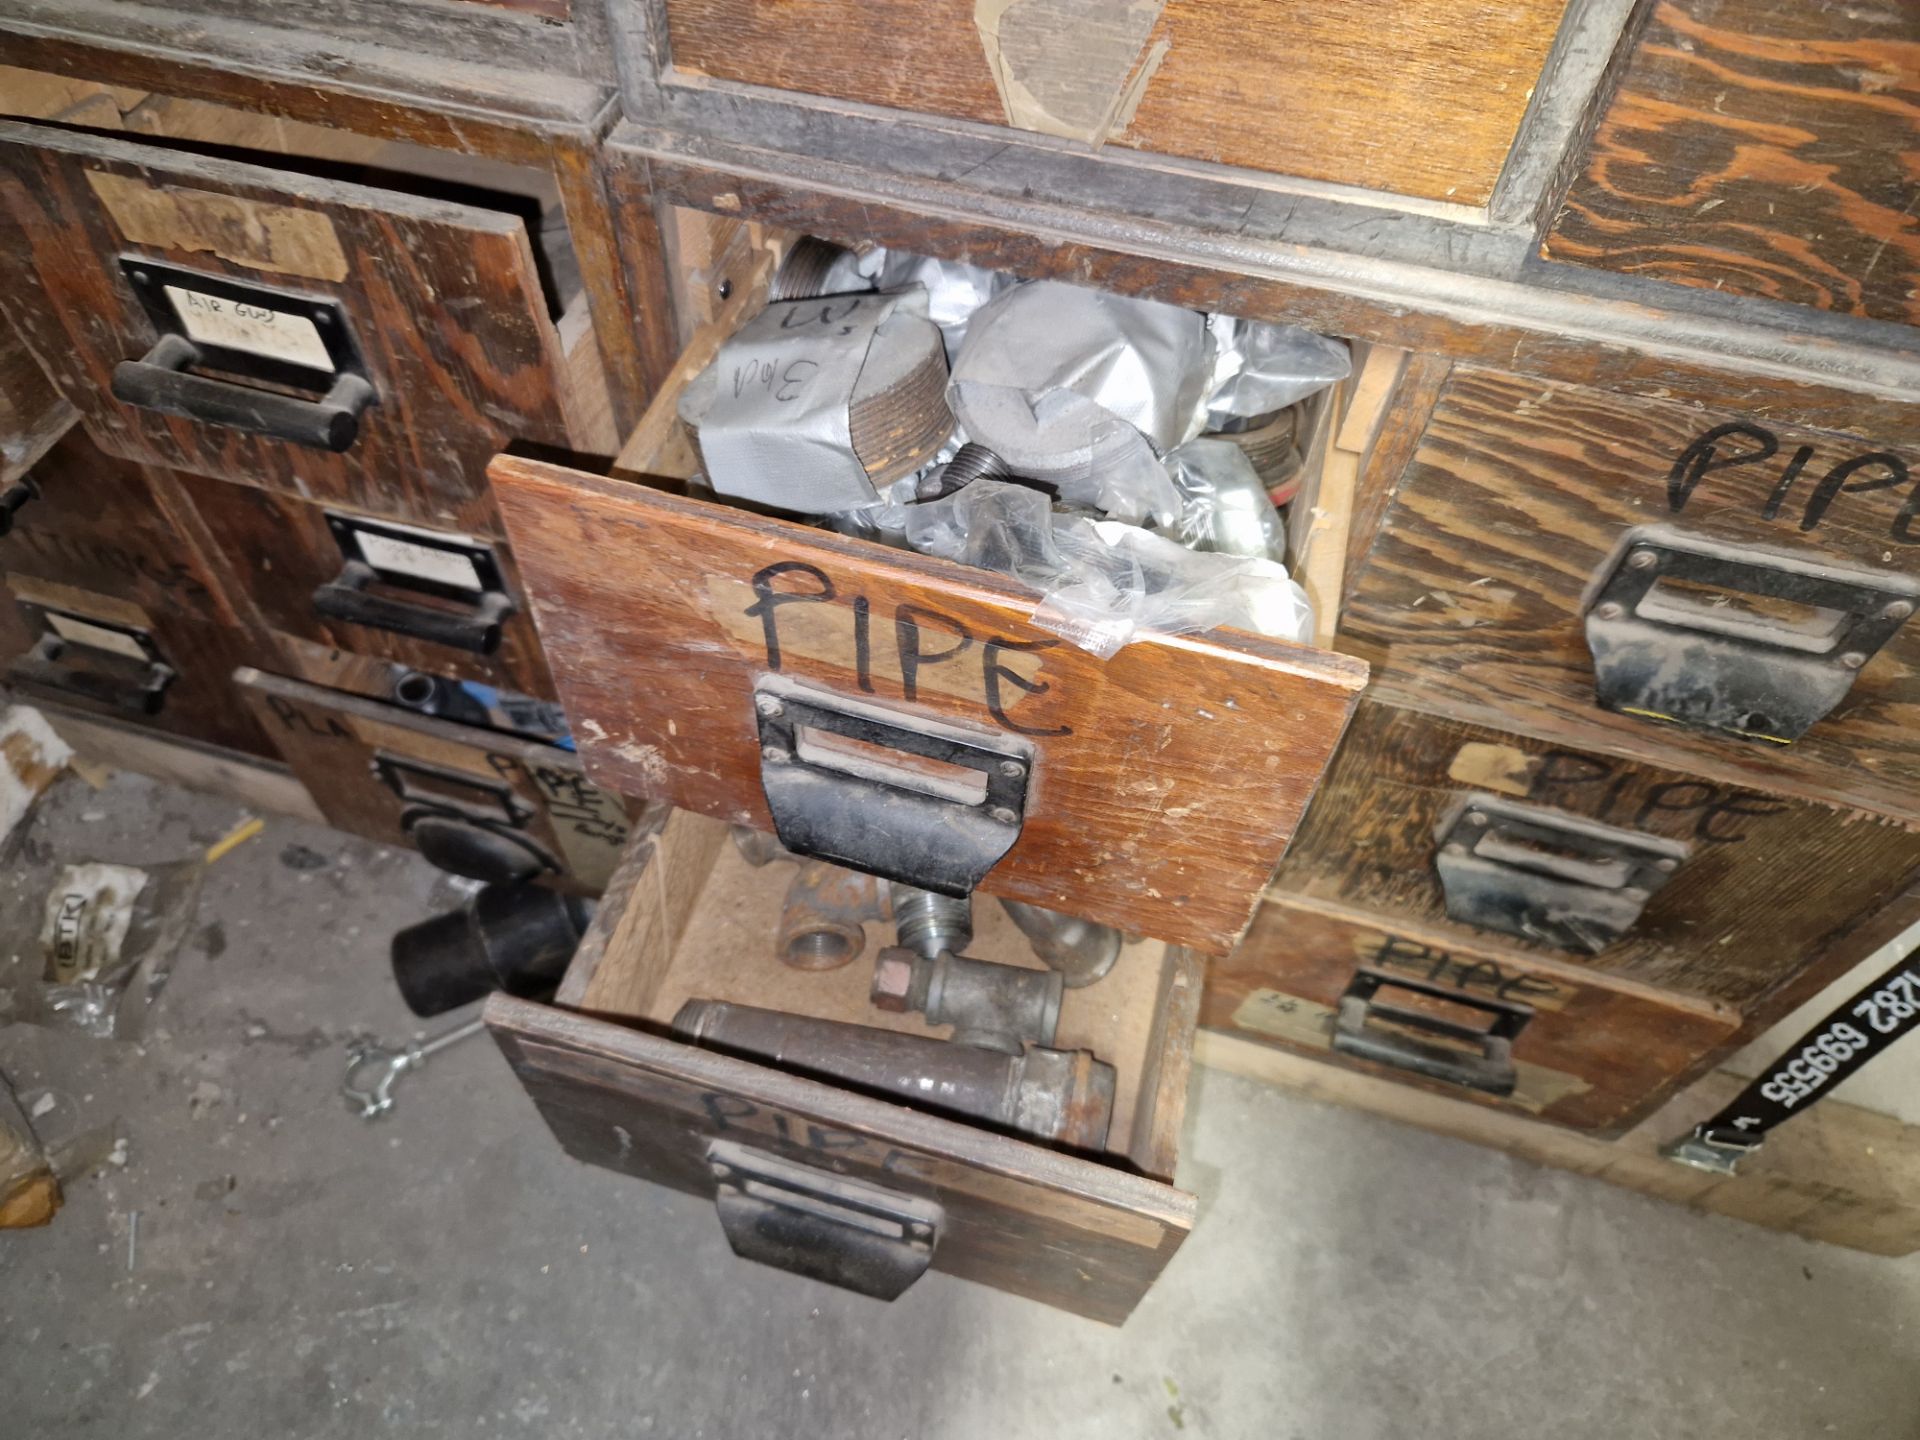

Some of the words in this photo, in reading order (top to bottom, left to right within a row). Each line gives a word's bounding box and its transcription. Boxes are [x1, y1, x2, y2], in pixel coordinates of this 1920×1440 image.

[185, 290, 223, 313] AIR
[735, 561, 1073, 736] PIPE
[1526, 751, 1790, 844] PIPE
[1374, 934, 1559, 998] PIPE
[1760, 1022, 1869, 1109] 699555
